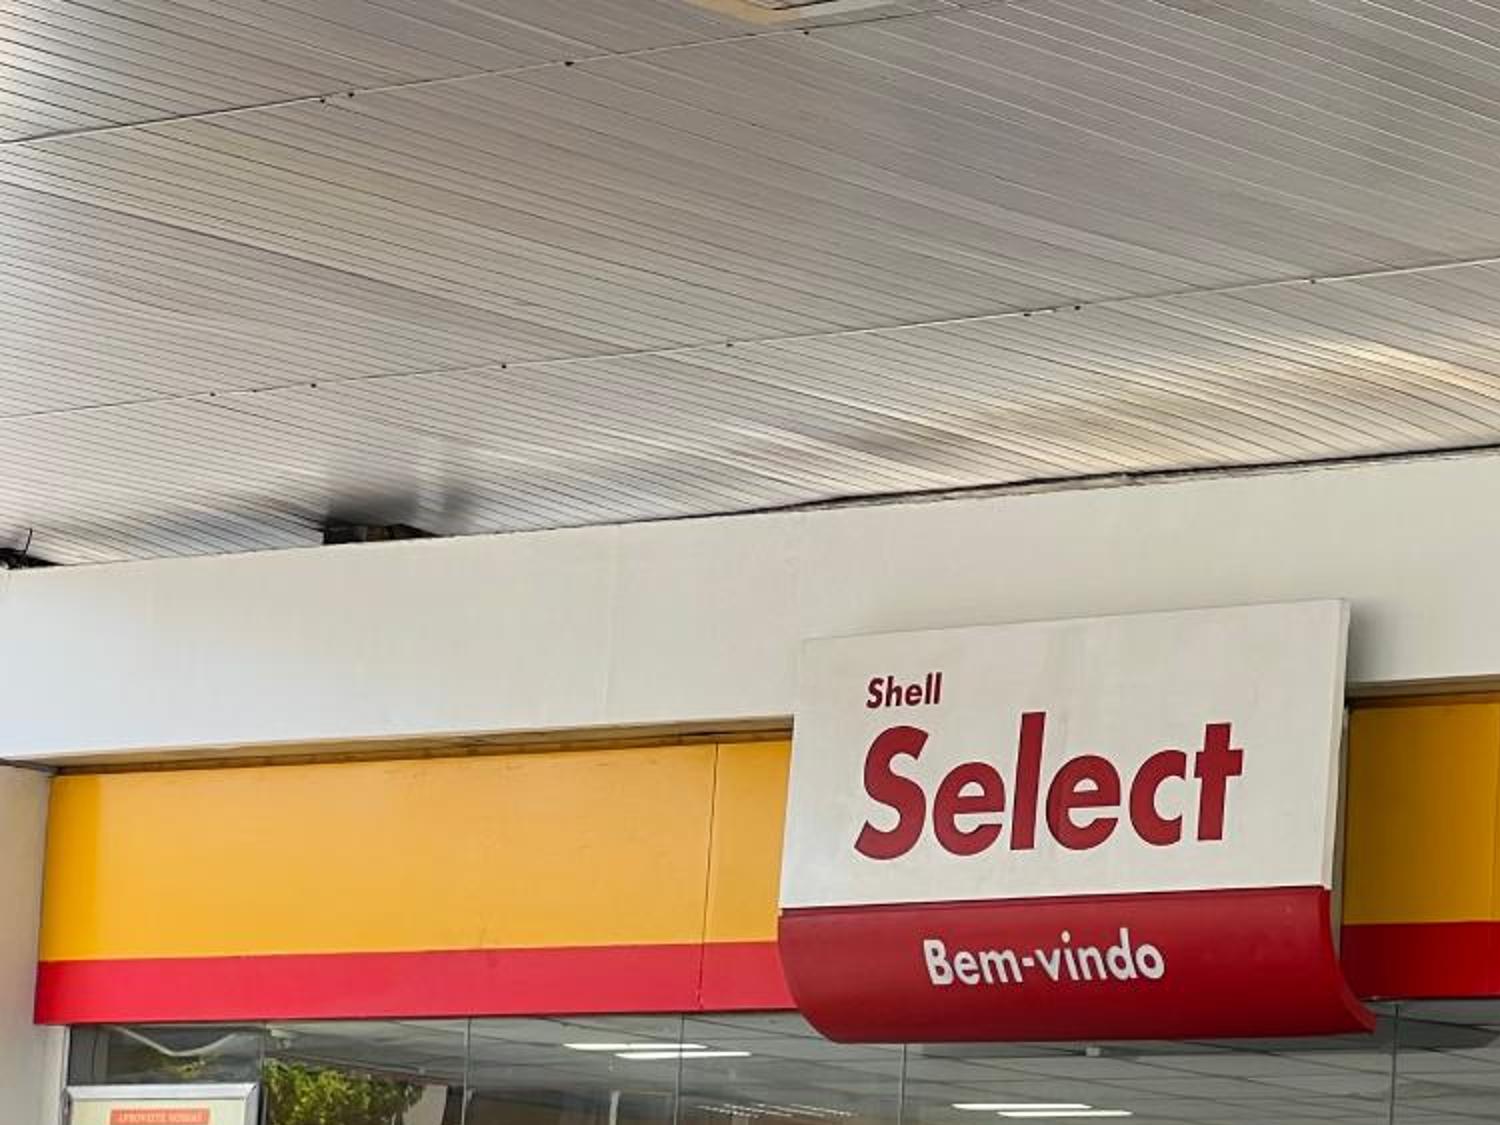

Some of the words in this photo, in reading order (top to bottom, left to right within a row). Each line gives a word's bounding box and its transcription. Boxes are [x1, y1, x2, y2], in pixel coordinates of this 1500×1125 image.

[866, 672, 942, 708] Shell
[854, 712, 1243, 860] Select
[923, 928, 1166, 987] Bem-vindo
